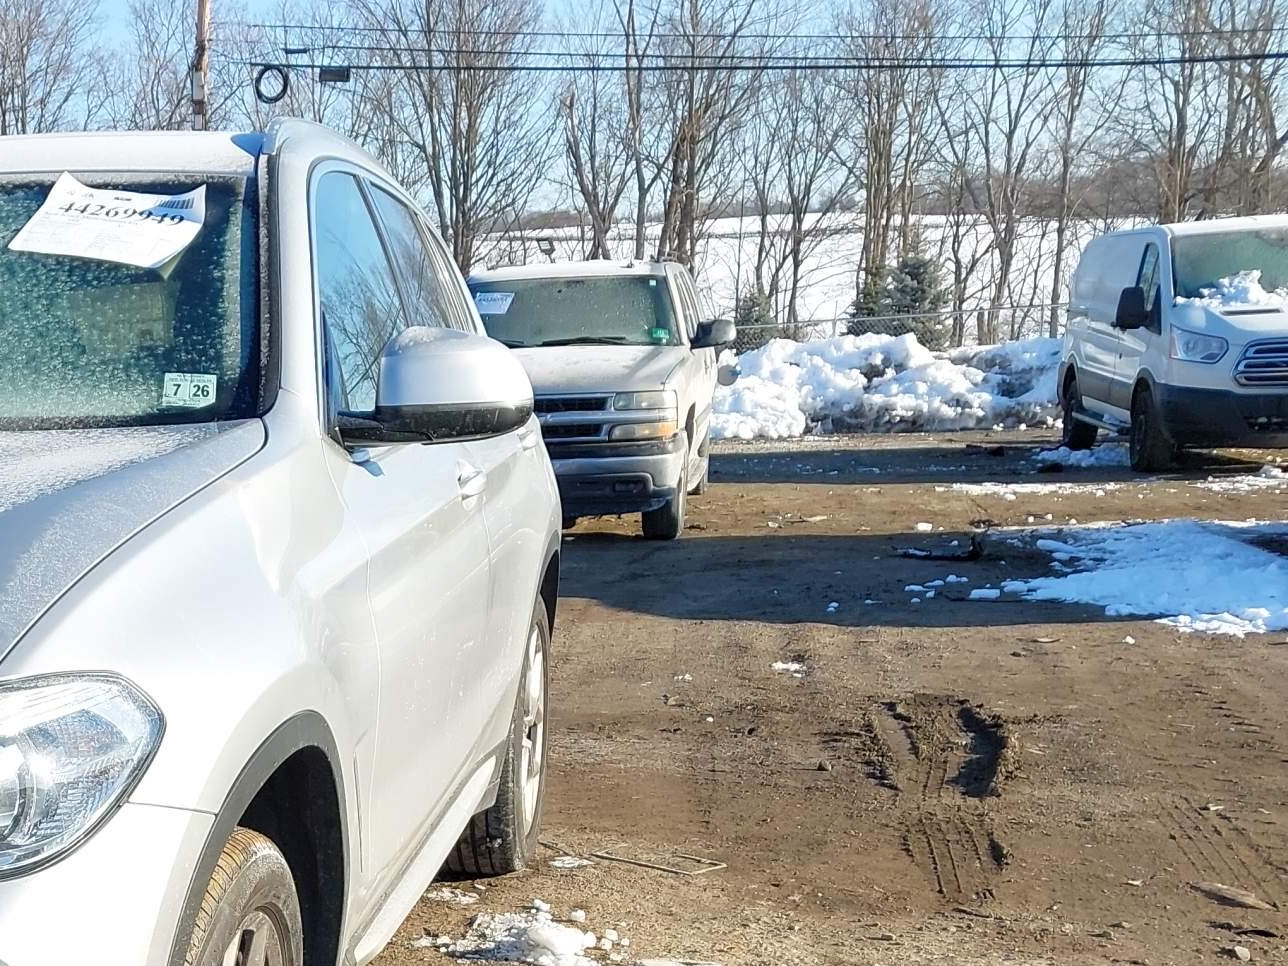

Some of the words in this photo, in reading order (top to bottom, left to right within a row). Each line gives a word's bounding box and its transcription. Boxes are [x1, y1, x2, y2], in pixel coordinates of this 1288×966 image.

[58, 201, 185, 226] 44269949
[172, 383, 182, 397] 7
[191, 384, 210, 398] 26
